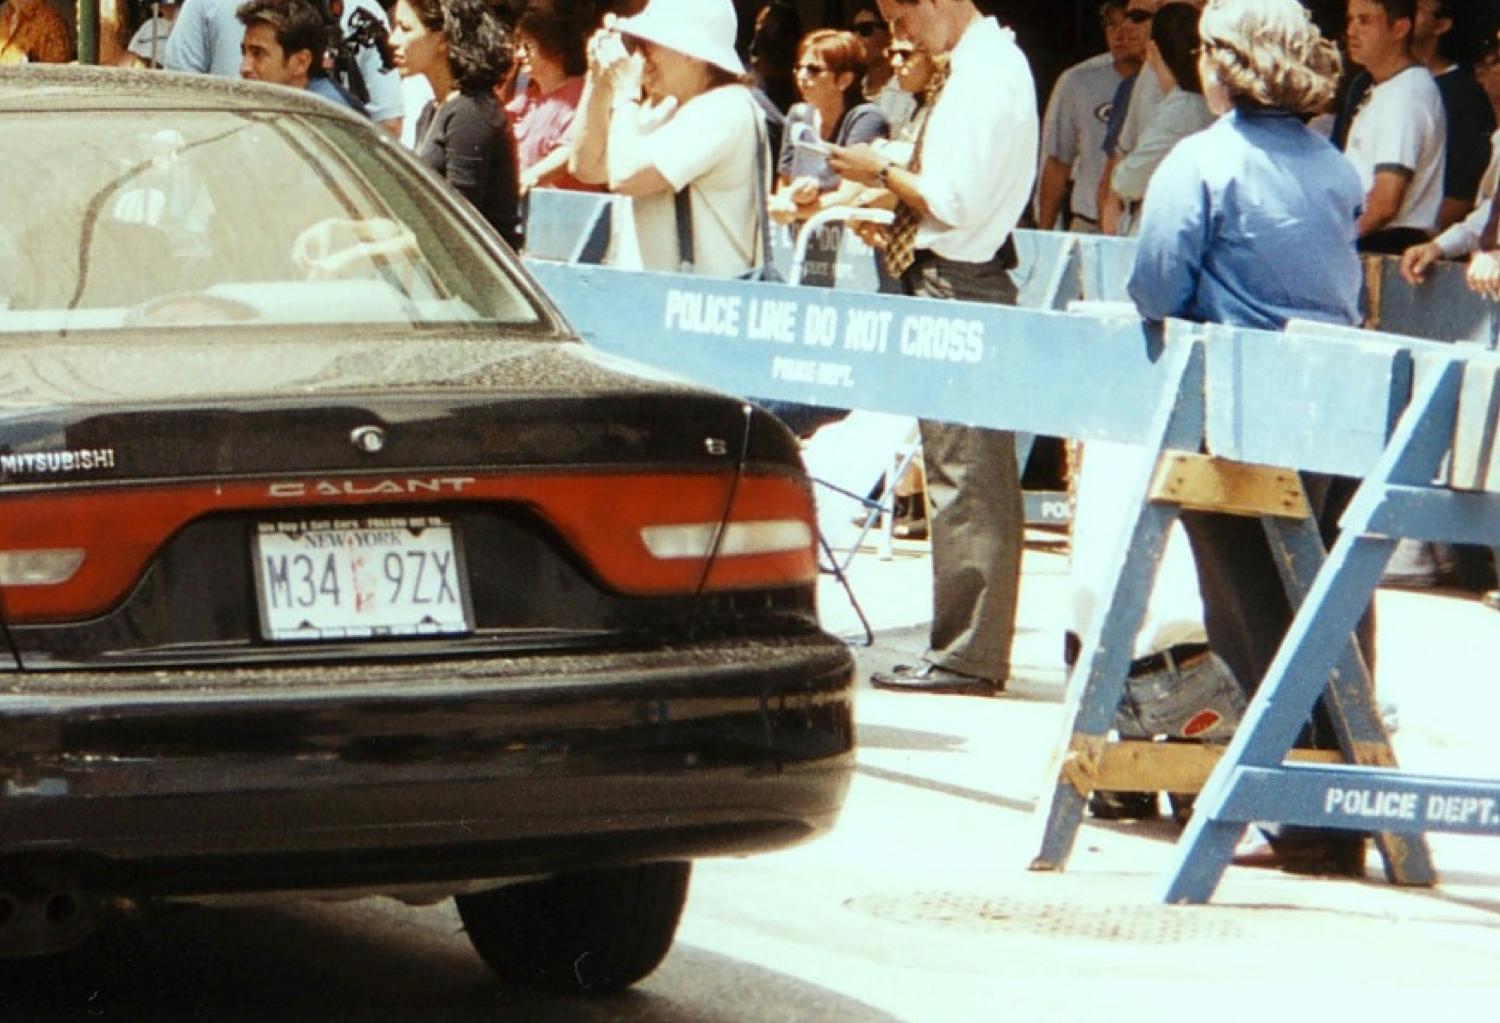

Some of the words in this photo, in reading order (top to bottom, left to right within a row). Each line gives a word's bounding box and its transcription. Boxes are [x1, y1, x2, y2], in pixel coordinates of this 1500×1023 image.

[664, 289, 741, 338] POLICE
[747, 297, 798, 344] LINE
[804, 304, 838, 348] DO
[844, 307, 893, 355] NOT
[900, 314, 985, 364] CROSS
[771, 356, 816, 384] POLICE
[0, 448, 115, 473] MITSUBISHI
[268, 477, 476, 497] GALANT
[305, 532, 344, 549] NEW
[355, 530, 403, 547] YORK
[267, 553, 340, 608] M34
[384, 550, 456, 605] 9ZX
[1324, 787, 1418, 820] POLICE
[1425, 794, 1500, 825] DEPT.
